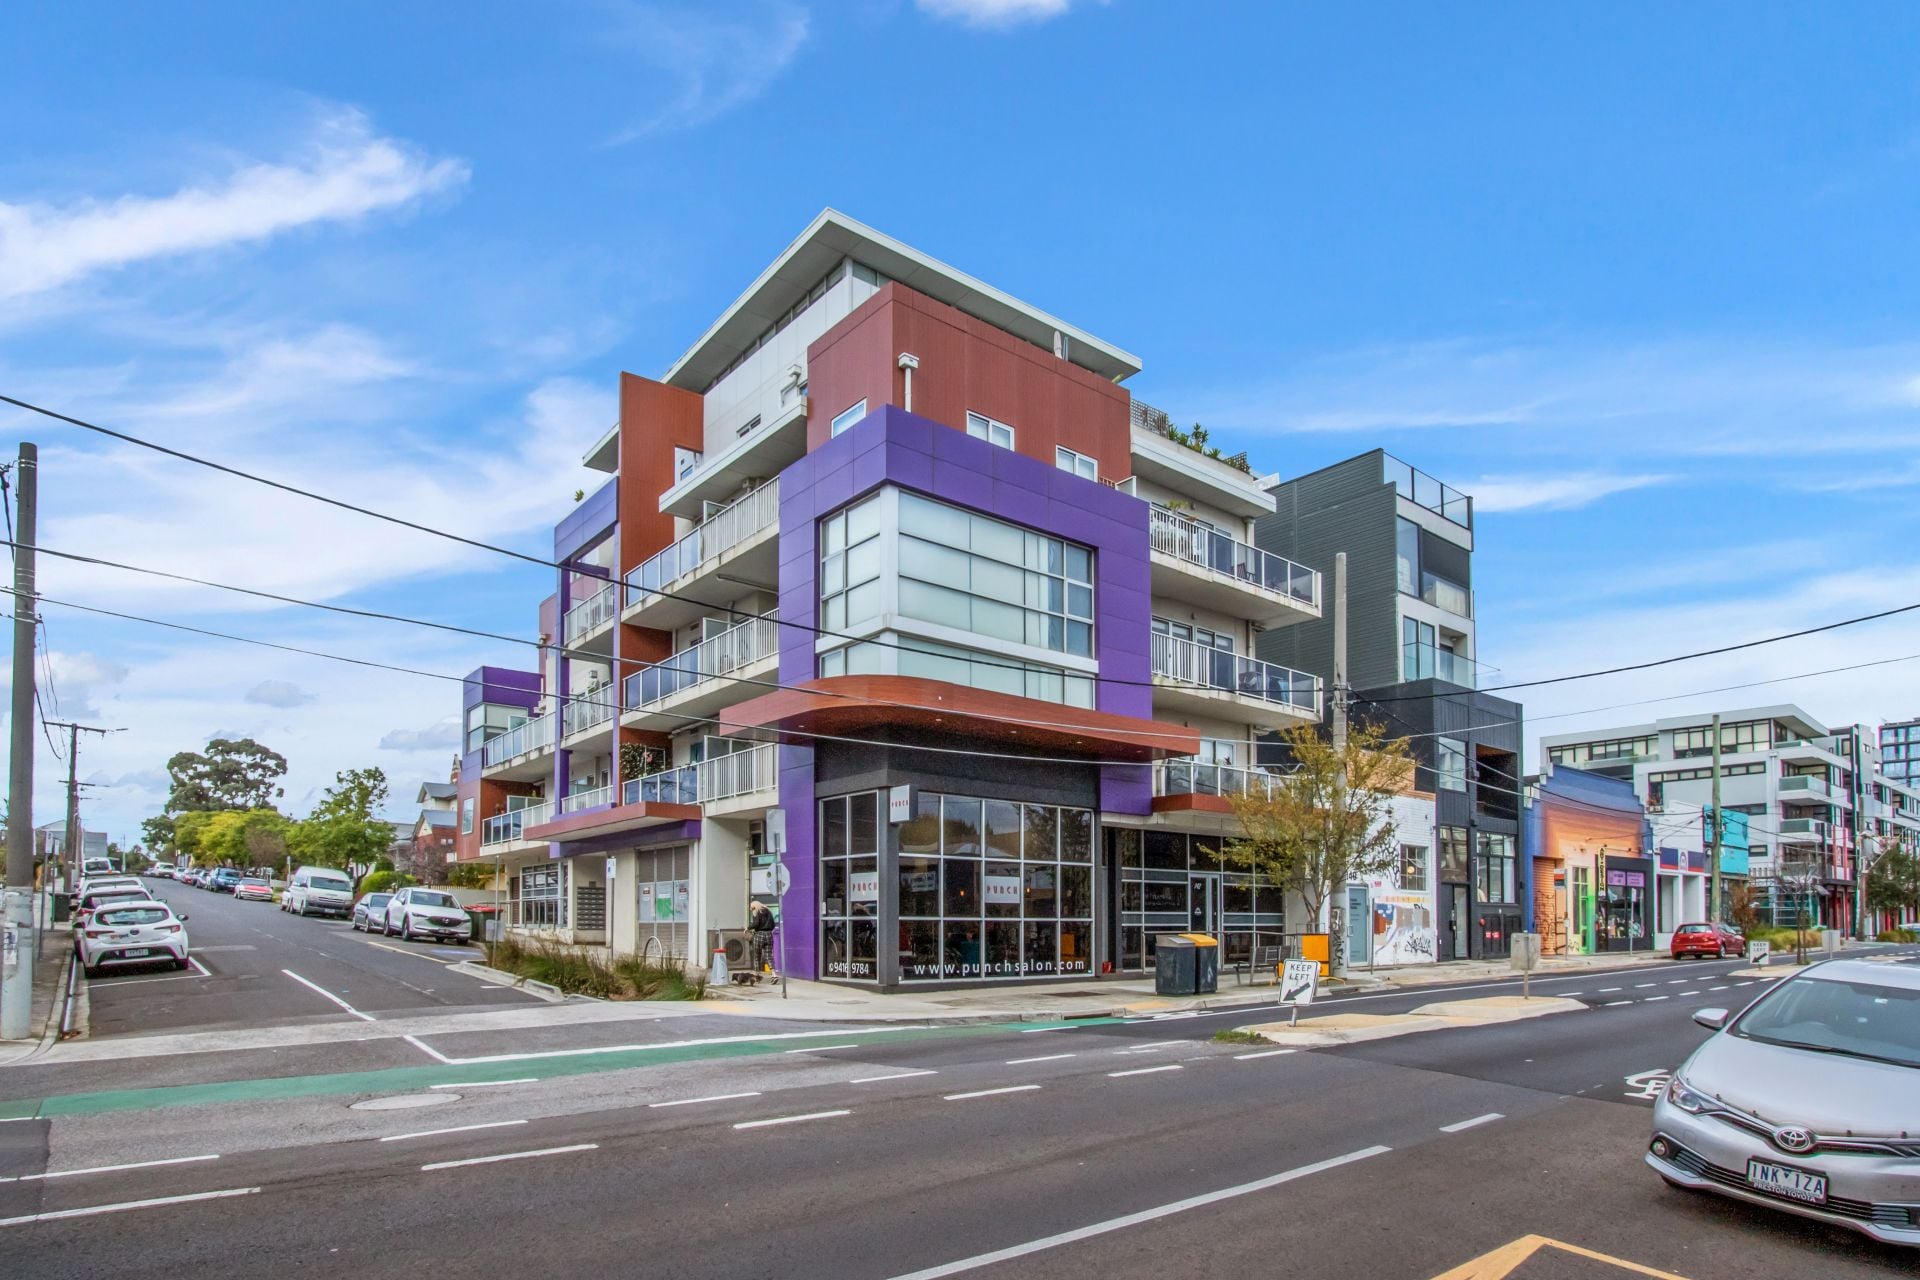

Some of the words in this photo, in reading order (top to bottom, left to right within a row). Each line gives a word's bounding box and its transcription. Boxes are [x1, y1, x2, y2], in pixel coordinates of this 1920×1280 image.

[852, 882, 877, 892] PUNCH
[986, 886, 1018, 895] PUNCH
[834, 962, 849, 973] 9416
[851, 962, 869, 975] 9784
[913, 958, 1085, 977] www.punchsalon.com
[1290, 963, 1313, 973] KEEP
[1288, 973, 1310, 981] LEFT
[1753, 1182, 1786, 1195] PRESTON
[1787, 1190, 1817, 1203] TOYOTA
